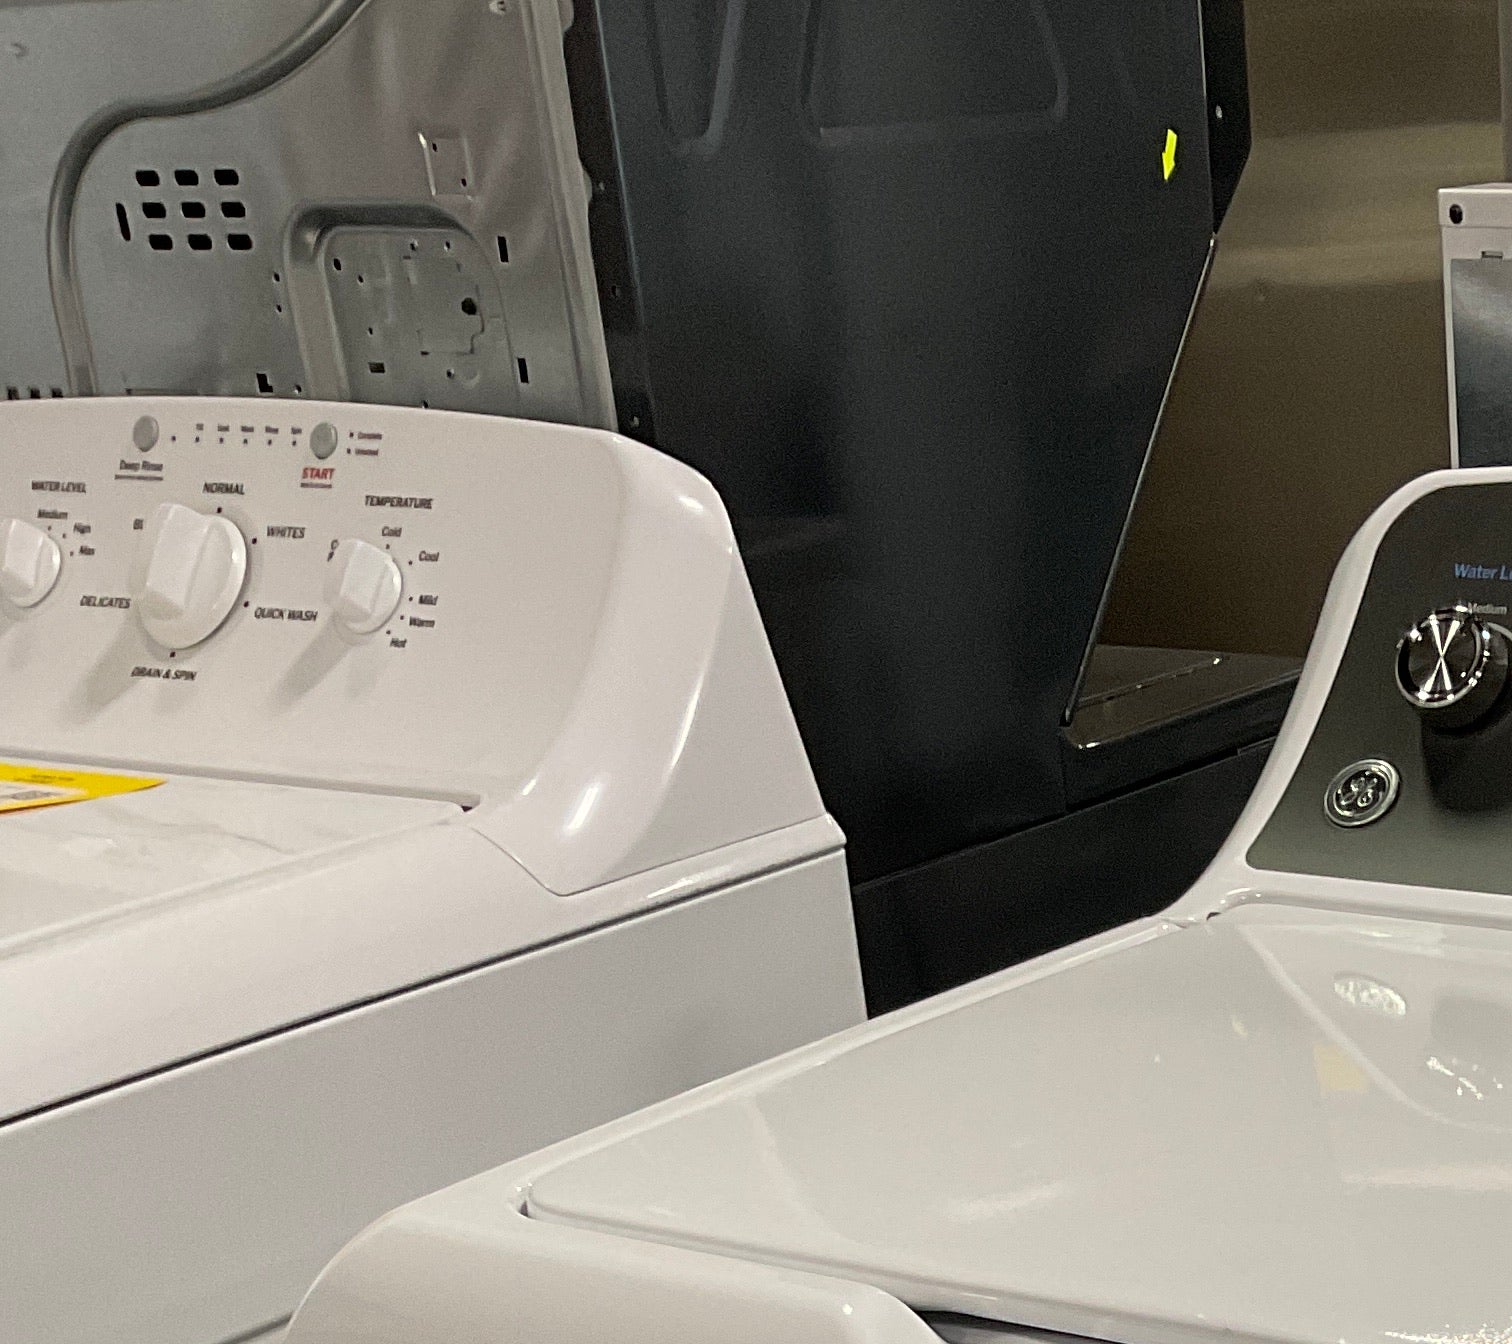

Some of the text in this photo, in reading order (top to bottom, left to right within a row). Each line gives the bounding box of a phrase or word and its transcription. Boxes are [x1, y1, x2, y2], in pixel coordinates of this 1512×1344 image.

[302, 467, 335, 480] START
[61, 482, 86, 493] LEVEL
[203, 482, 245, 495] NORMAL
[365, 495, 433, 509] TEMPERATURE
[267, 526, 306, 539] WHITES
[382, 526, 402, 537] Cold
[419, 551, 440, 562] Cool
[1454, 563, 1498, 579] Water
[80, 596, 131, 609] DELICATES
[254, 607, 318, 621] QUICK WASH
[131, 667, 161, 679] DRAIN
[172, 670, 197, 682] SPIN
